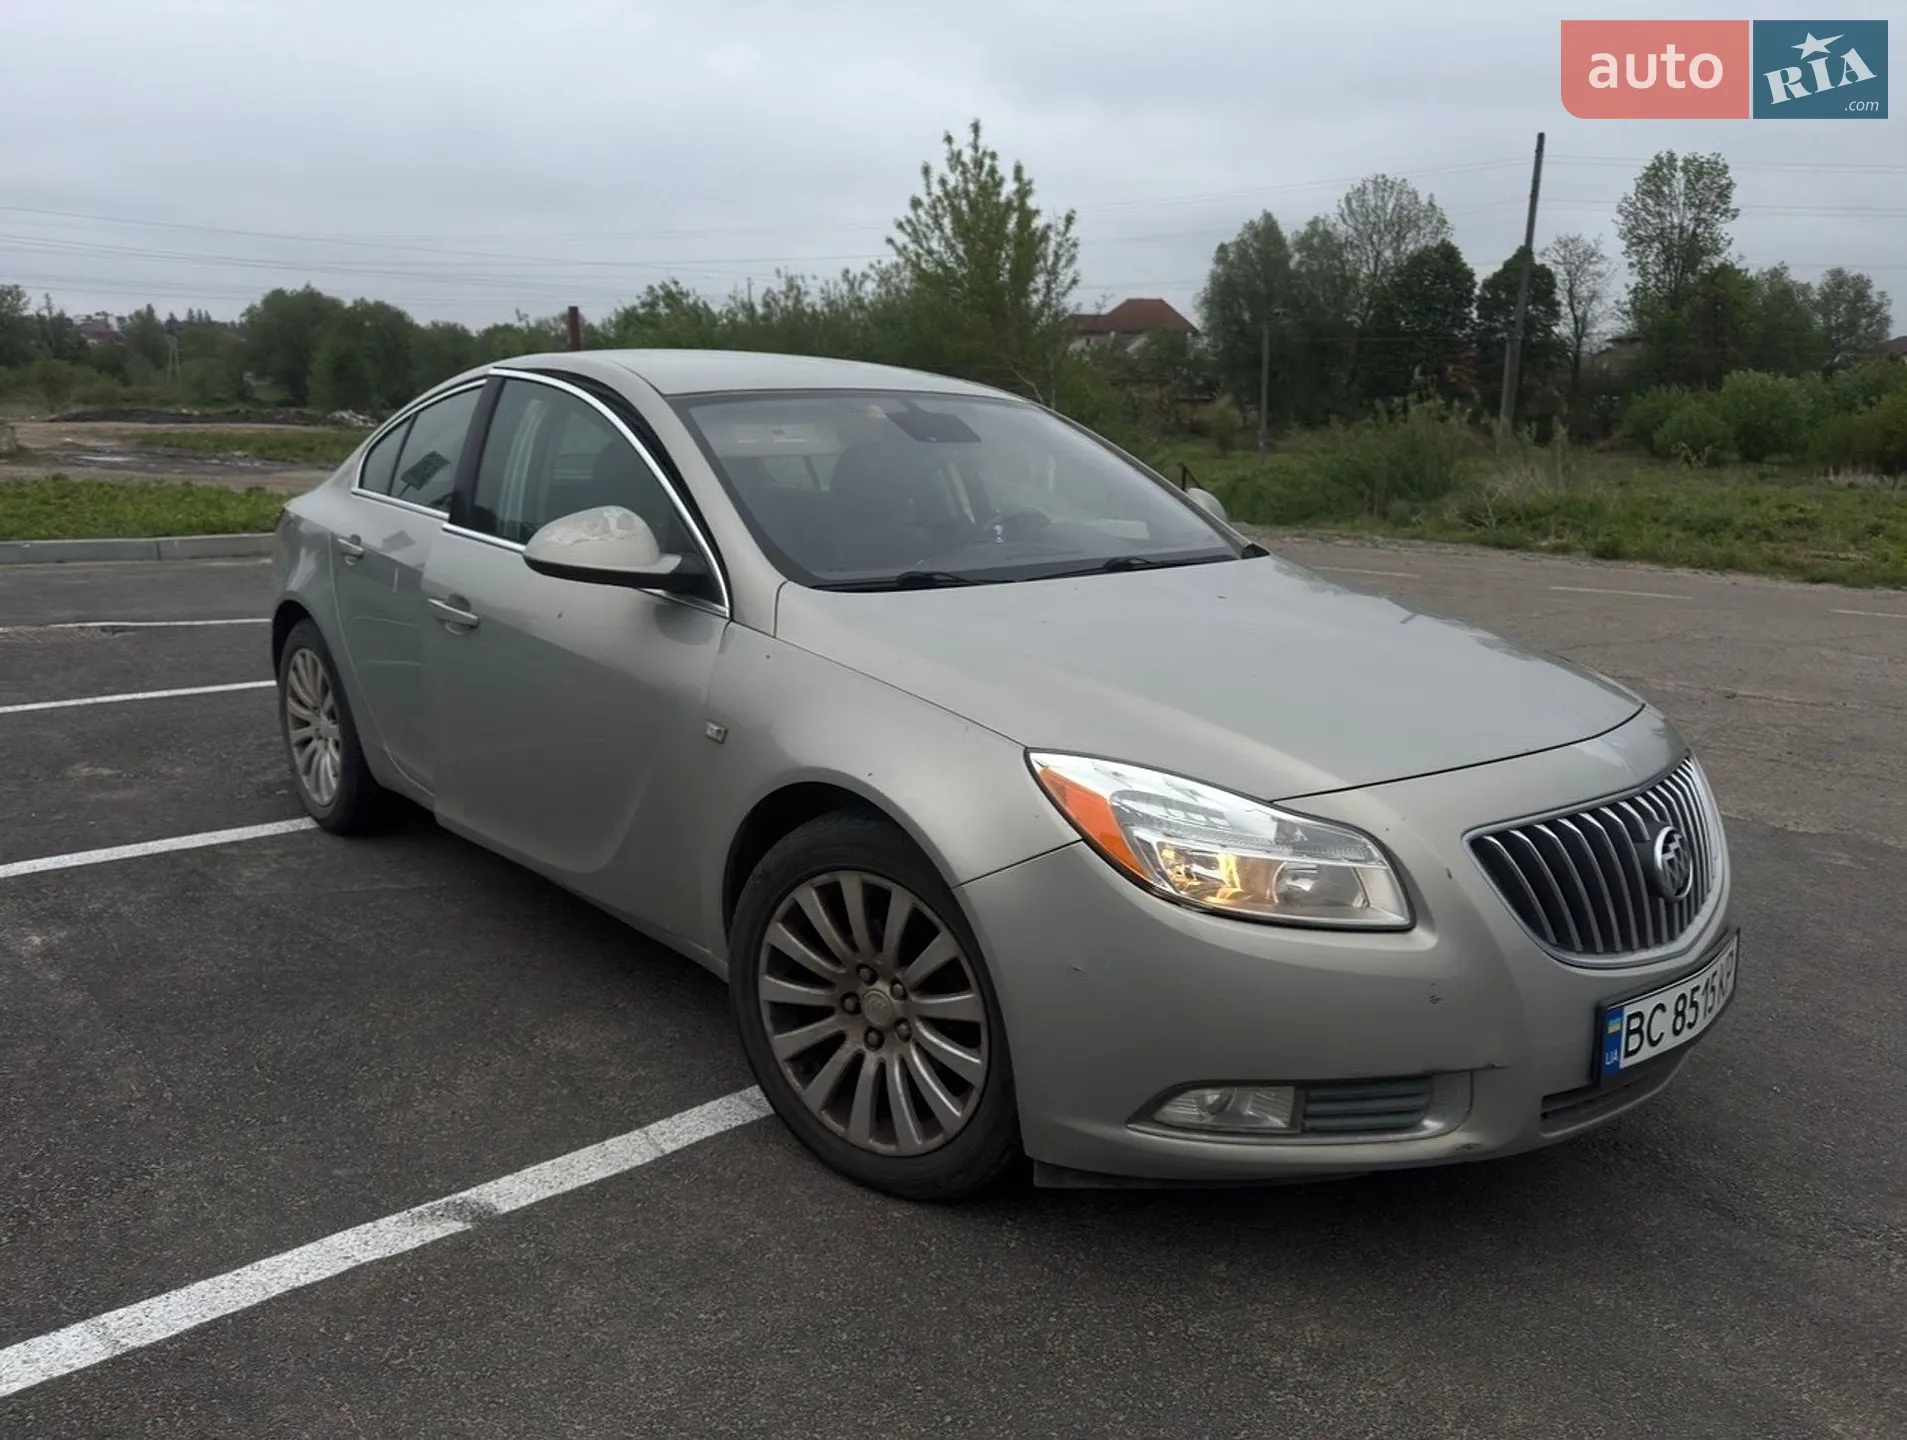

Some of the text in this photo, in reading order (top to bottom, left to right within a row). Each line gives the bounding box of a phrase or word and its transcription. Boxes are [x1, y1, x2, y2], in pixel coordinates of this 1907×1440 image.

[1623, 1003, 1667, 1059] BC
[1672, 969, 1717, 1037] 8515
[1605, 1049, 1619, 1065] UA
